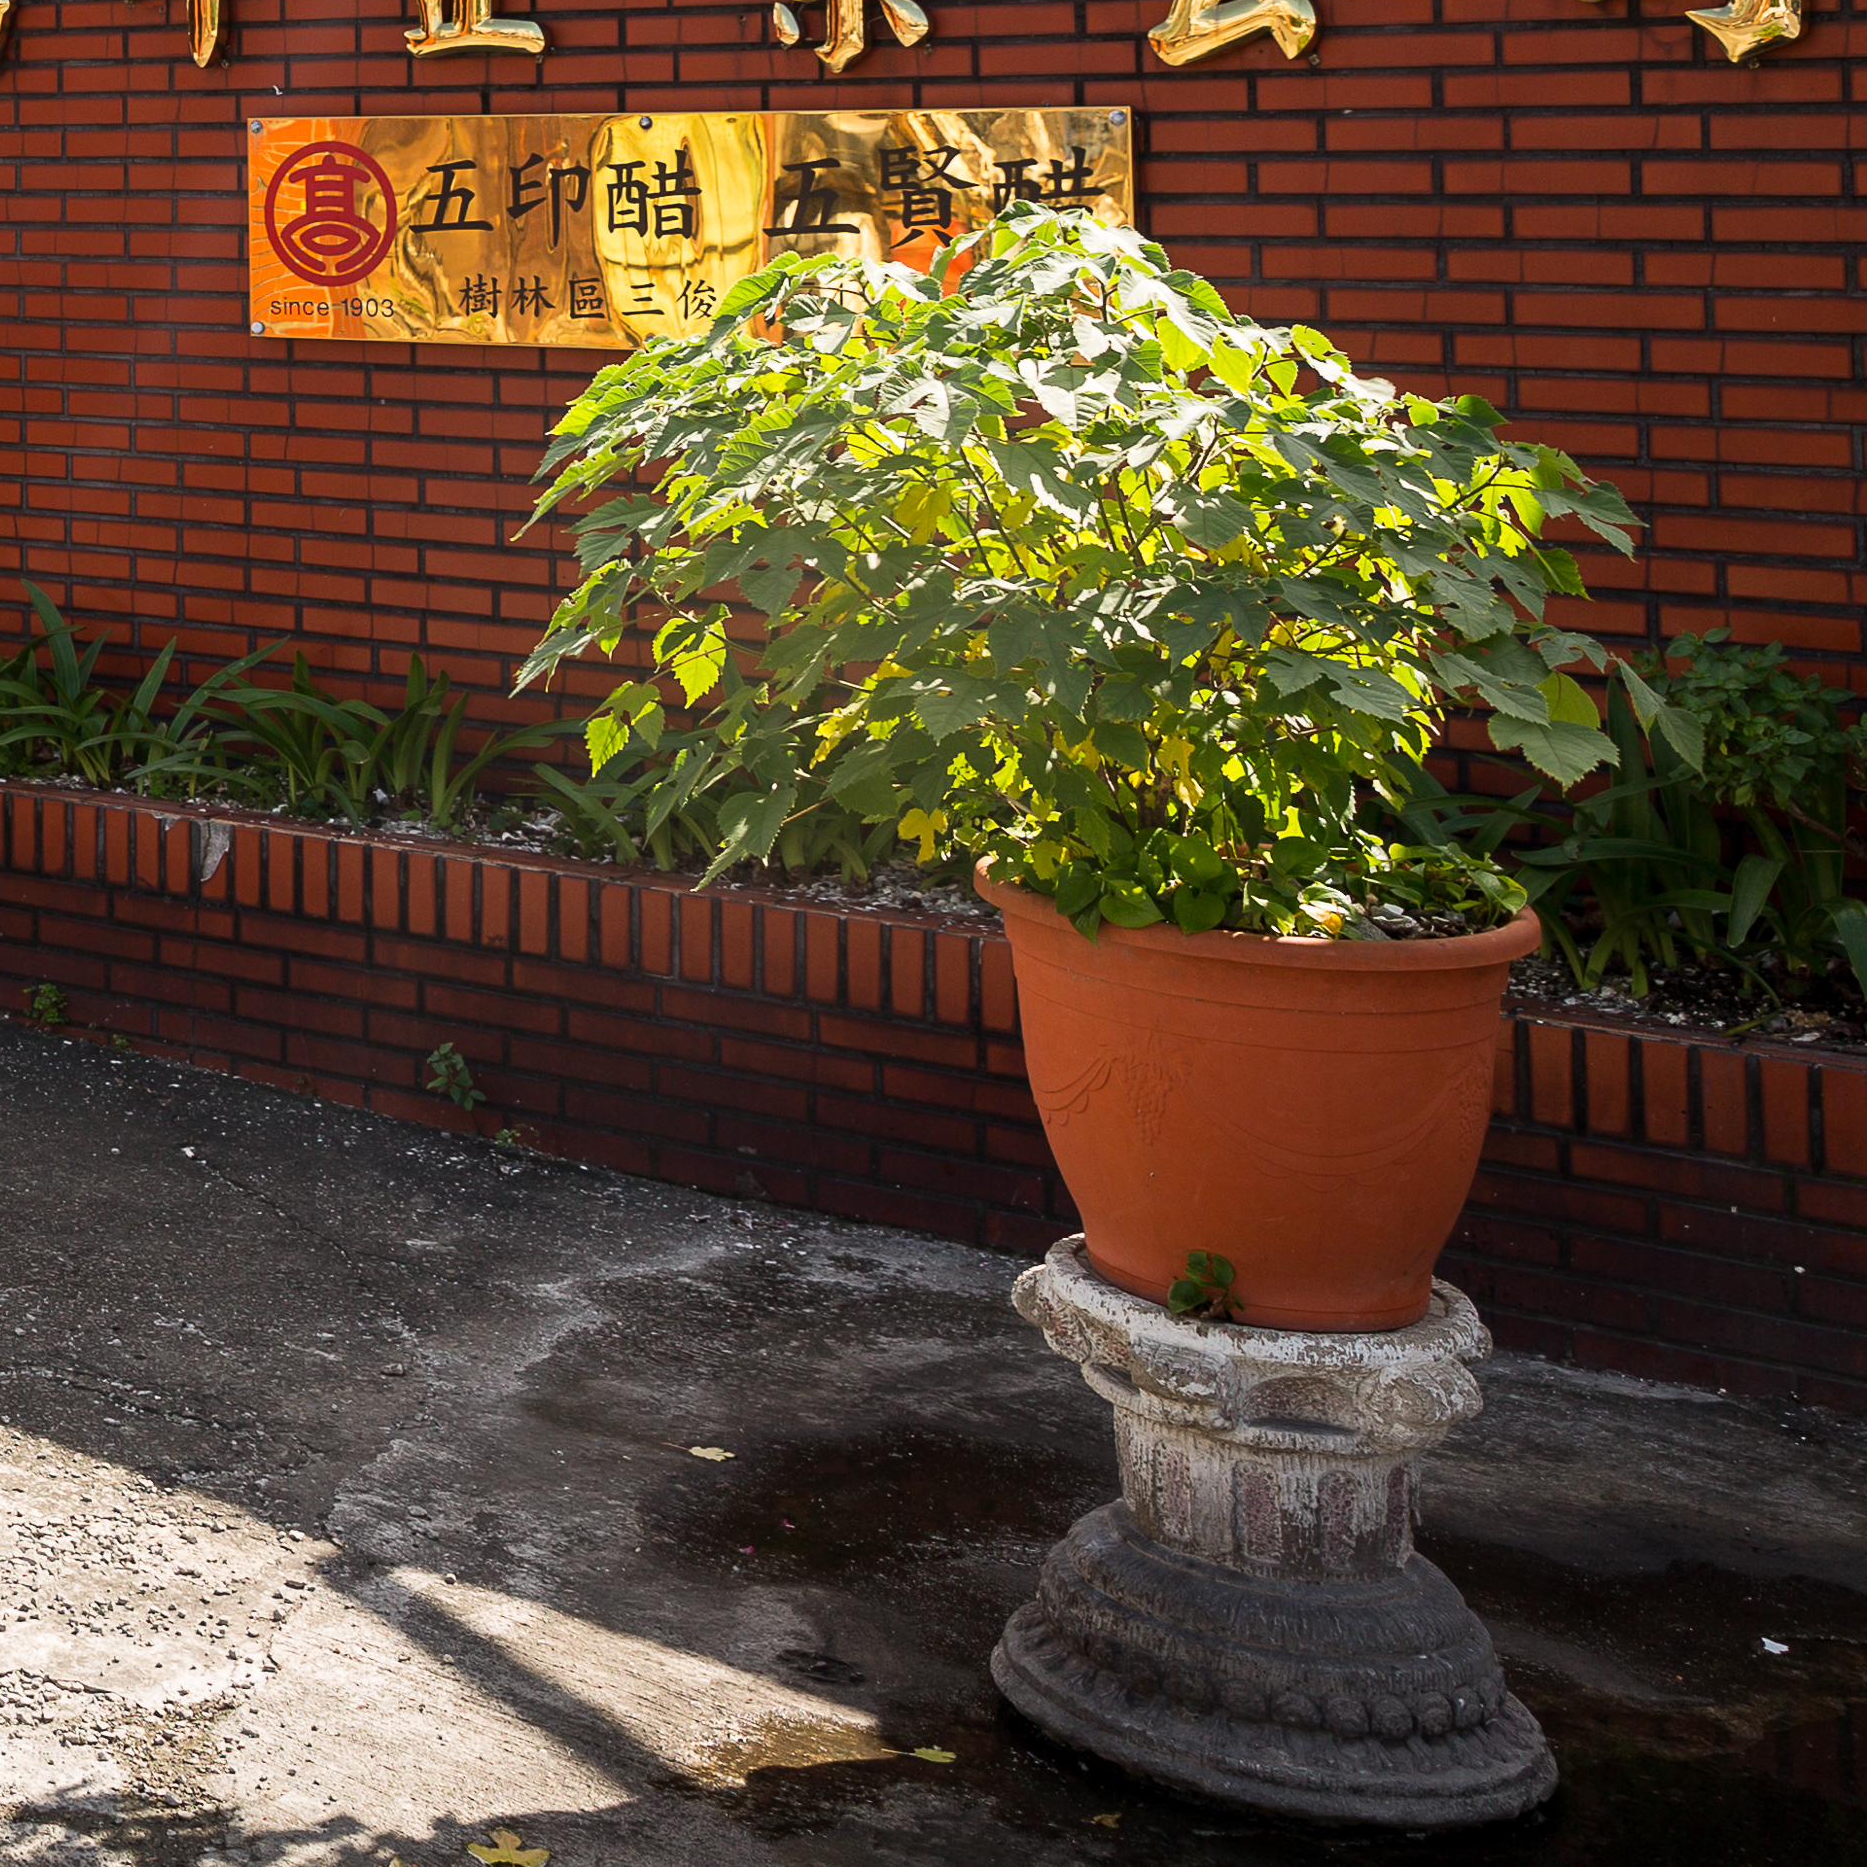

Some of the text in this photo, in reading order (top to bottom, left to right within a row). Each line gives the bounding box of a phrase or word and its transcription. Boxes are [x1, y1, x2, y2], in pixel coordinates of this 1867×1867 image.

[408, 148, 703, 249] 五印醋
[270, 296, 395, 318] since 1903
